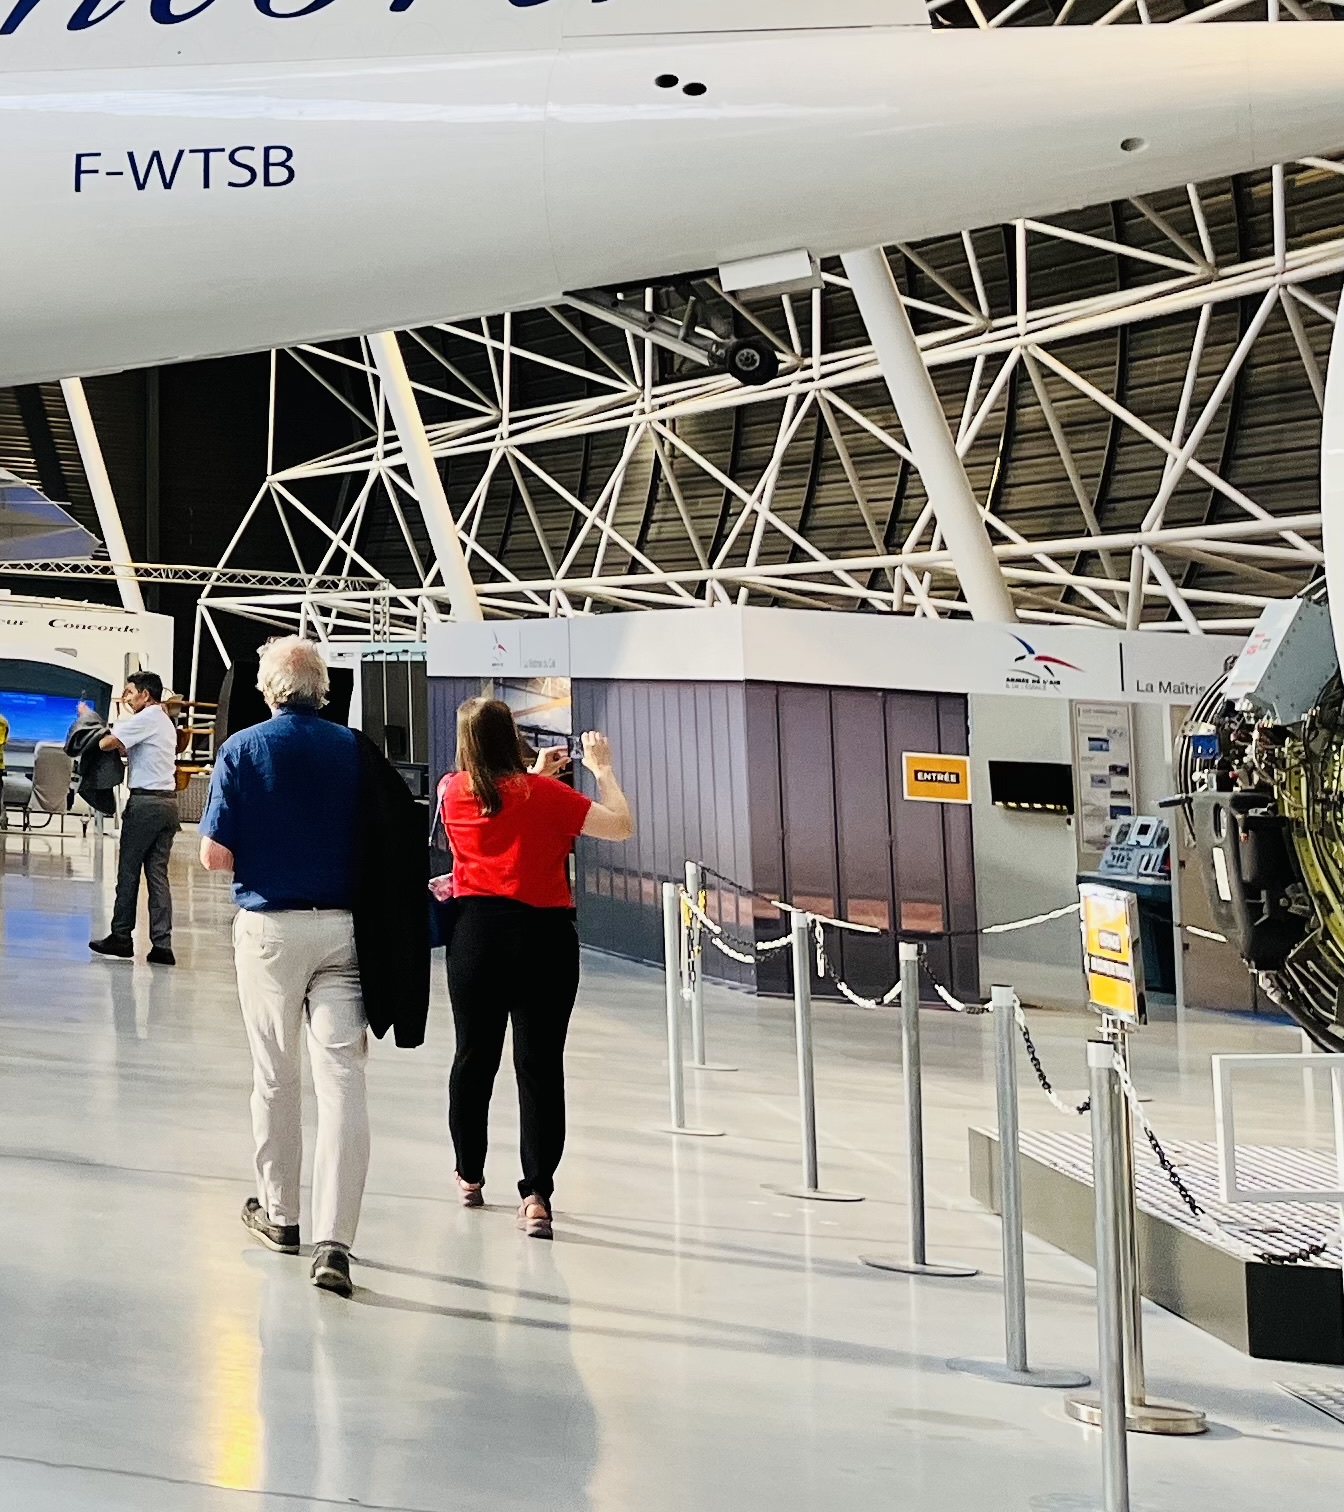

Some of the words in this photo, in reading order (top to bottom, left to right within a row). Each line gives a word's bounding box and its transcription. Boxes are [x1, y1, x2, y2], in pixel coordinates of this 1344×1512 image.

[71, 145, 297, 194] F-WTSB
[48, 618, 141, 634] Concorde
[1135, 679, 1154, 693] La
[917, 772, 957, 783] ENTRÉE
